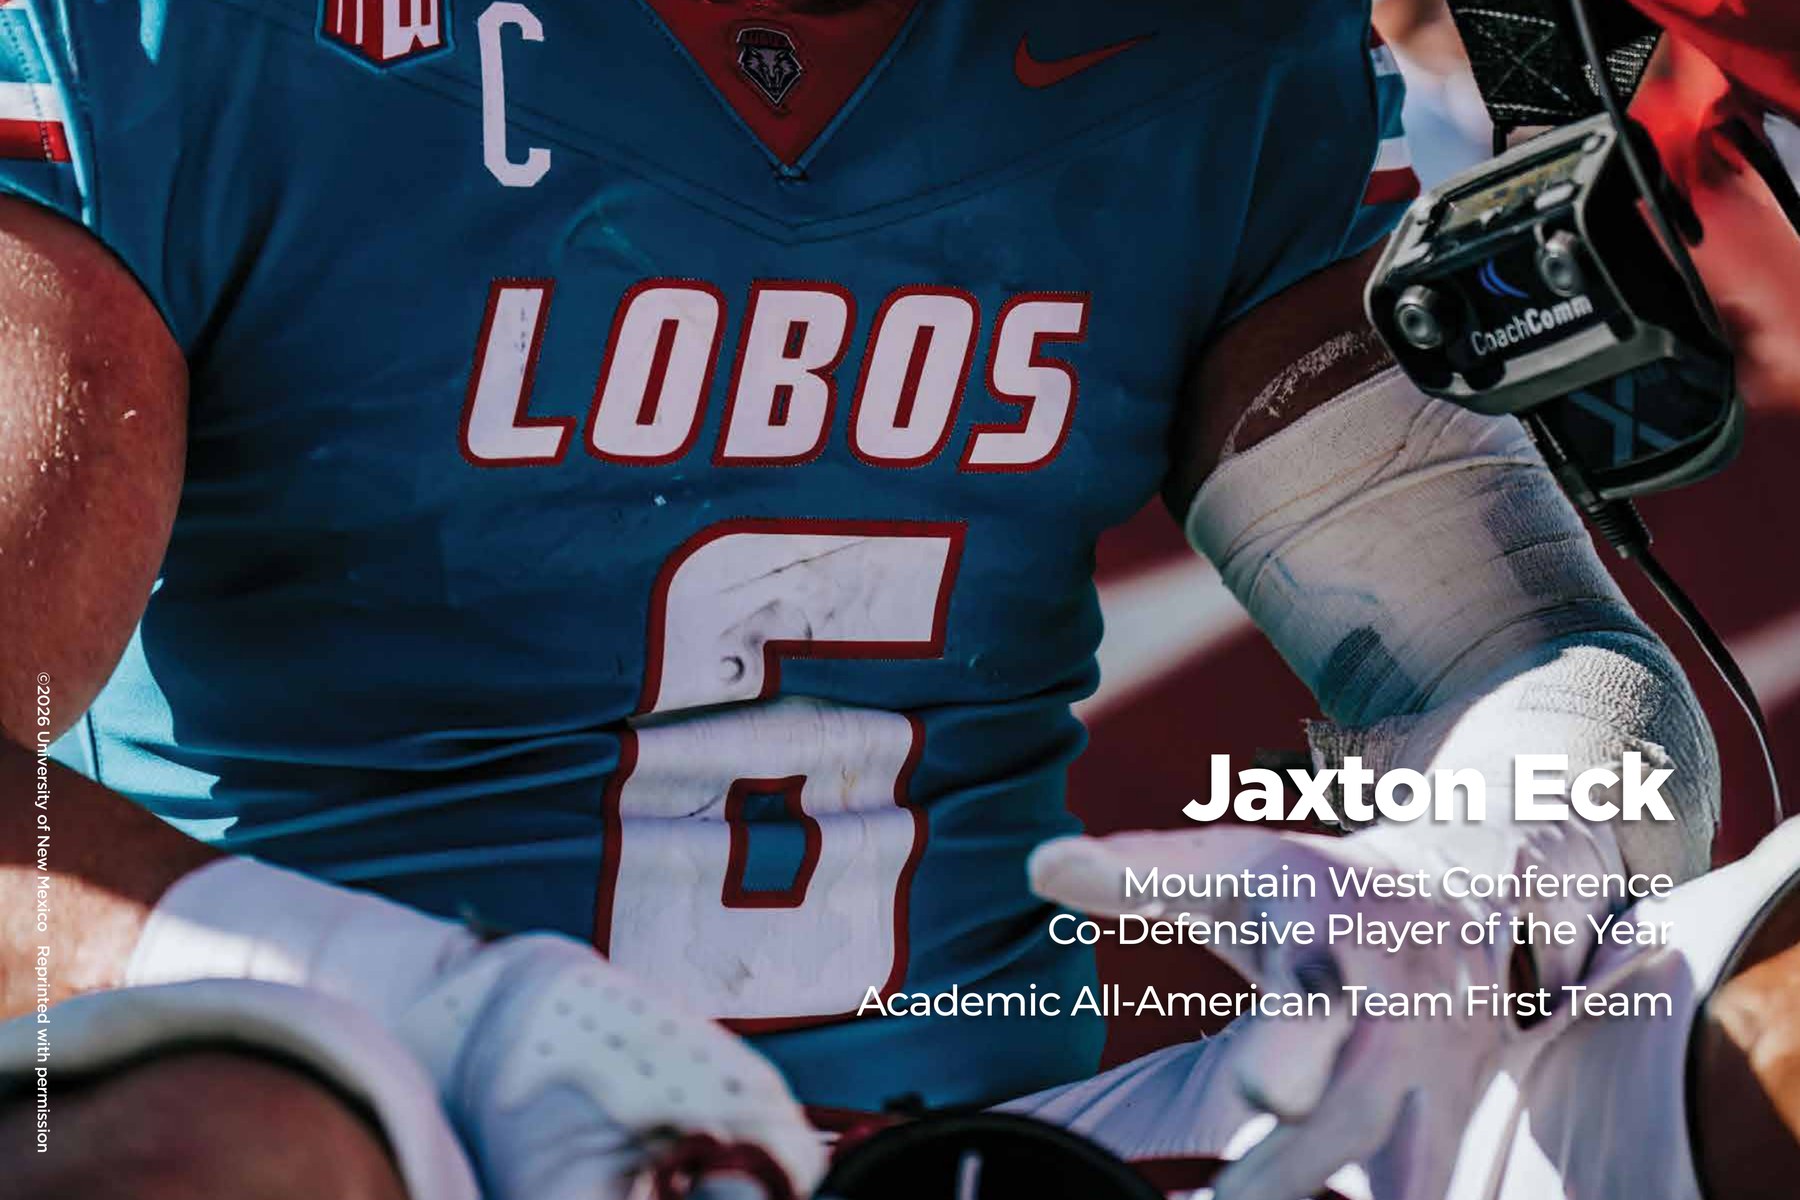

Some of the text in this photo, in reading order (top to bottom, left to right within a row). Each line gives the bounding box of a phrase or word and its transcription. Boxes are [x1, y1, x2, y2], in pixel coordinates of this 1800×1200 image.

[476, 1, 551, 188] C
[458, 277, 1093, 473] LOBOS
[1471, 296, 1594, 357] CoachComm
[592, 518, 967, 1039] 6
